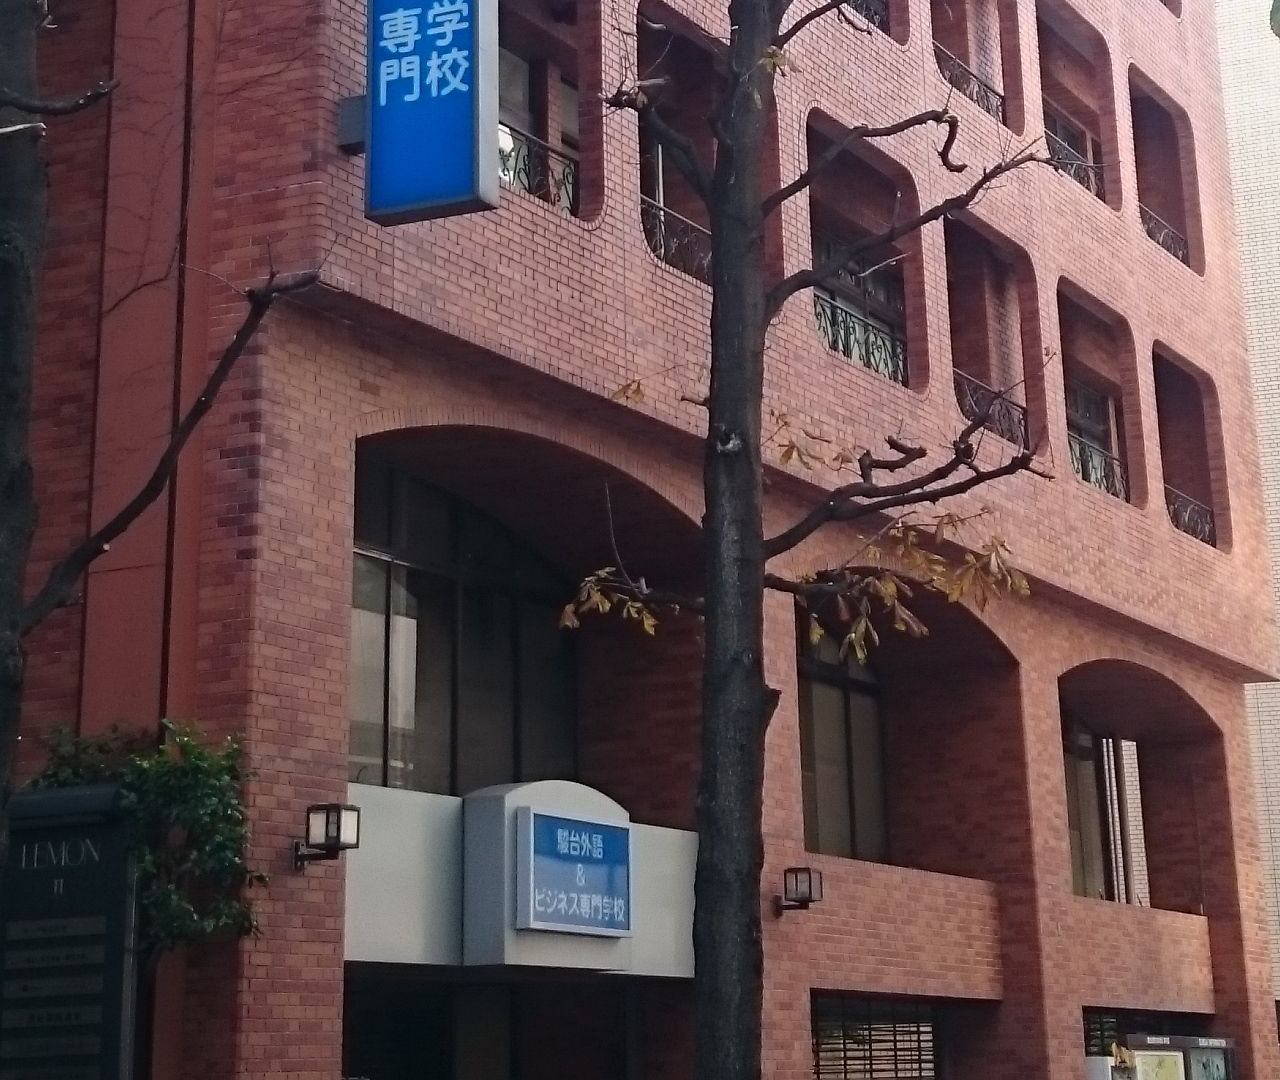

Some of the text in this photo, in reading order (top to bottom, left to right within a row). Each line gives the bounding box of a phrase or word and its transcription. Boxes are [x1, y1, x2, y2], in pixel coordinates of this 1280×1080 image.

[20, 837, 101, 869] LEMON
[557, 828, 604, 858] 駿台外語
[576, 863, 587, 886] &
[534, 888, 625, 922] ビジネス専門学校
